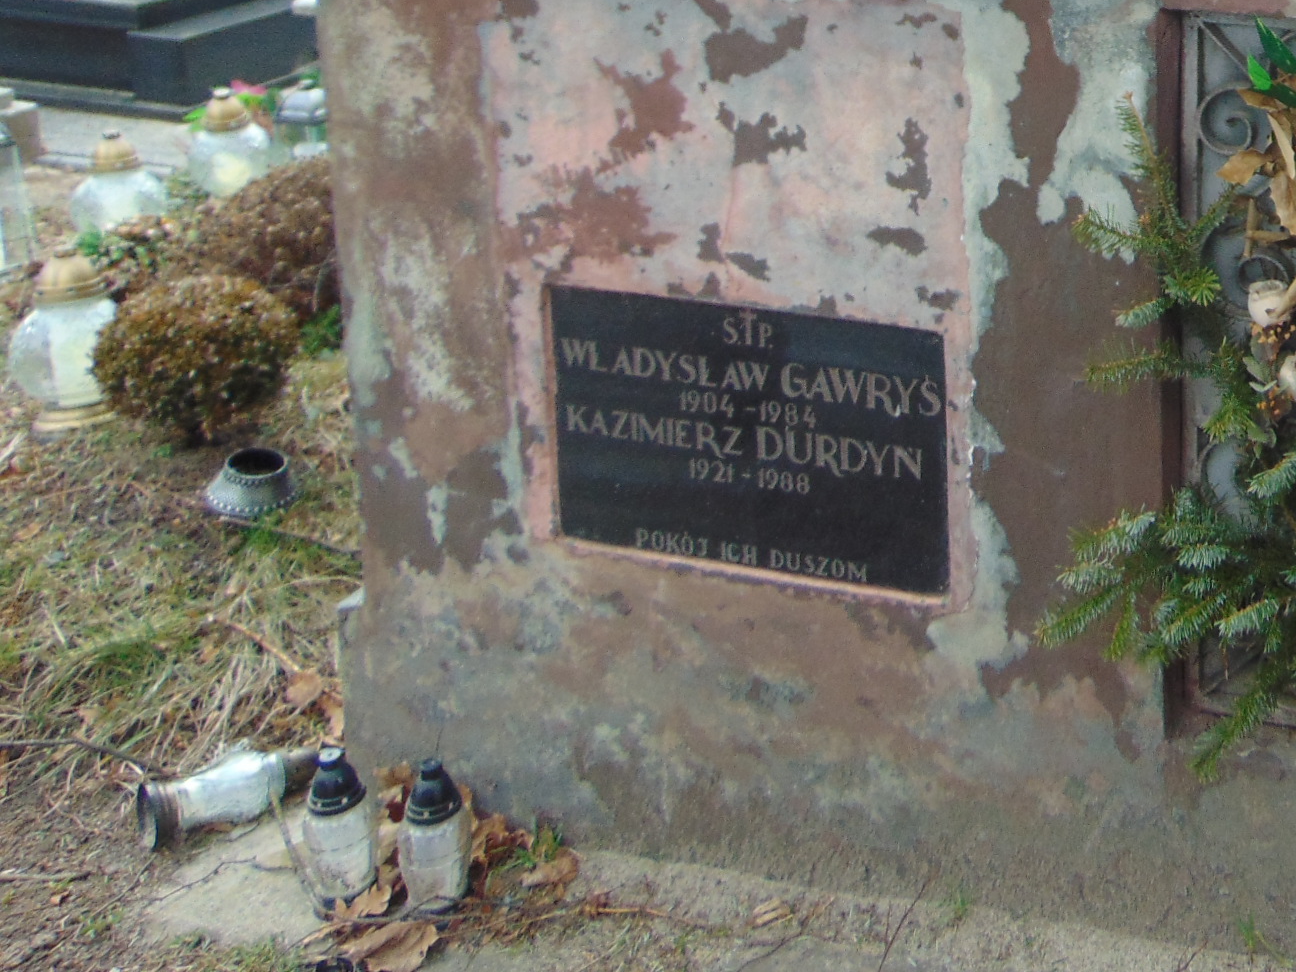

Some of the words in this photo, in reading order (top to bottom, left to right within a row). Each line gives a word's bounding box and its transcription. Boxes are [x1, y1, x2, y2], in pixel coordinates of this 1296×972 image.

[679, 389, 735, 419] 1904
[566, 402, 744, 460] KAZIMIERZ
[689, 457, 736, 484] 1921
[757, 467, 811, 496] 1988
[720, 539, 758, 566] ICH
[769, 548, 868, 583] DUSZOM
